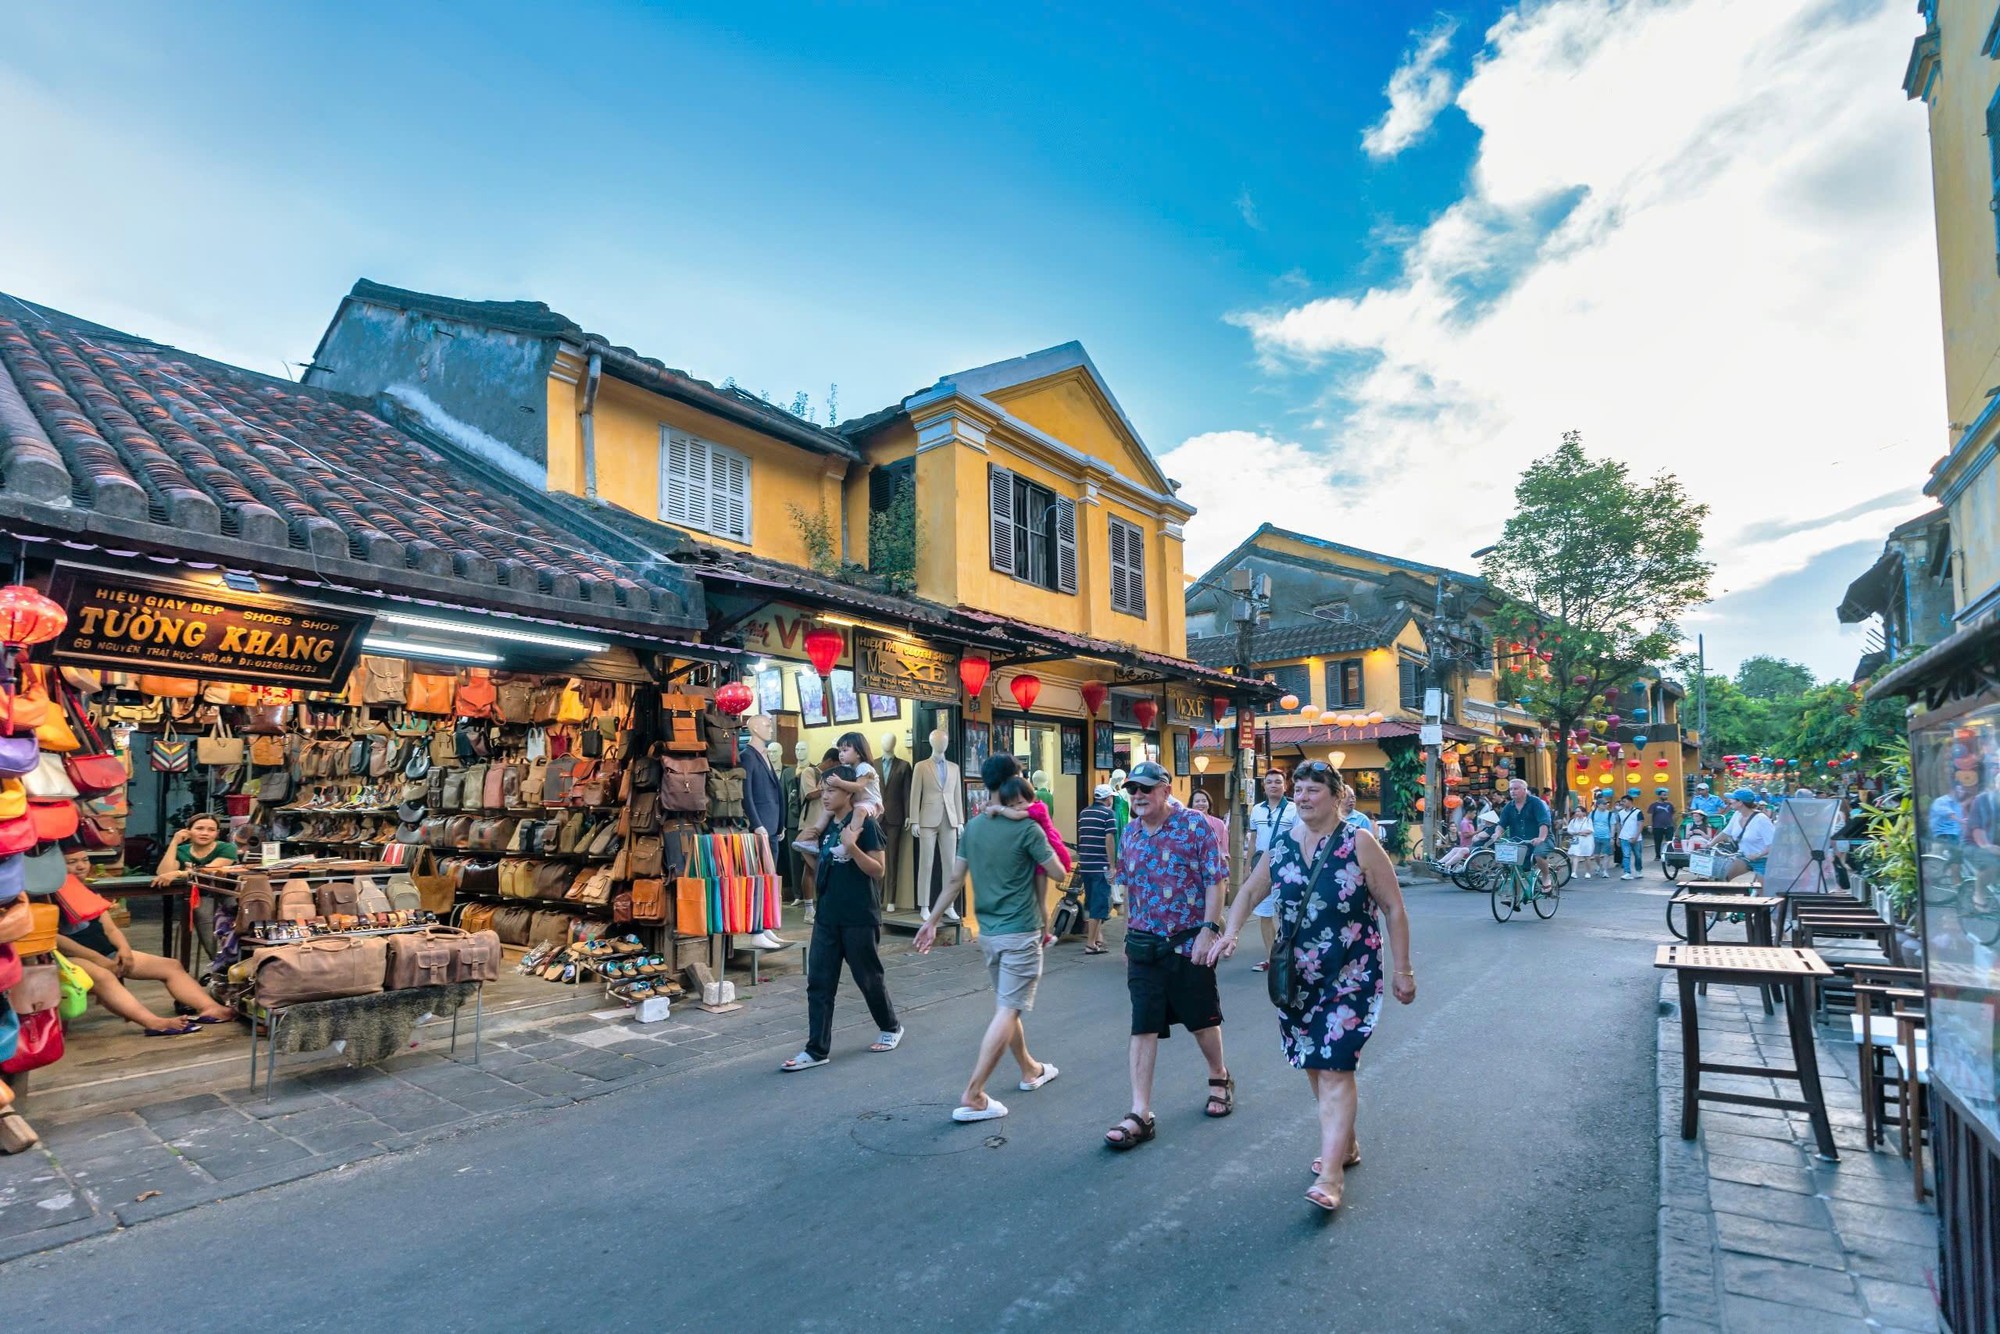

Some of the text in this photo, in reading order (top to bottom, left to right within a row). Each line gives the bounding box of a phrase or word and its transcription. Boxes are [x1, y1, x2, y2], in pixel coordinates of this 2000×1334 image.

[242, 611, 293, 626] SHOES
[300, 619, 340, 632] SHOP
[73, 638, 92, 649] 69
[218, 625, 335, 663] KHANG
